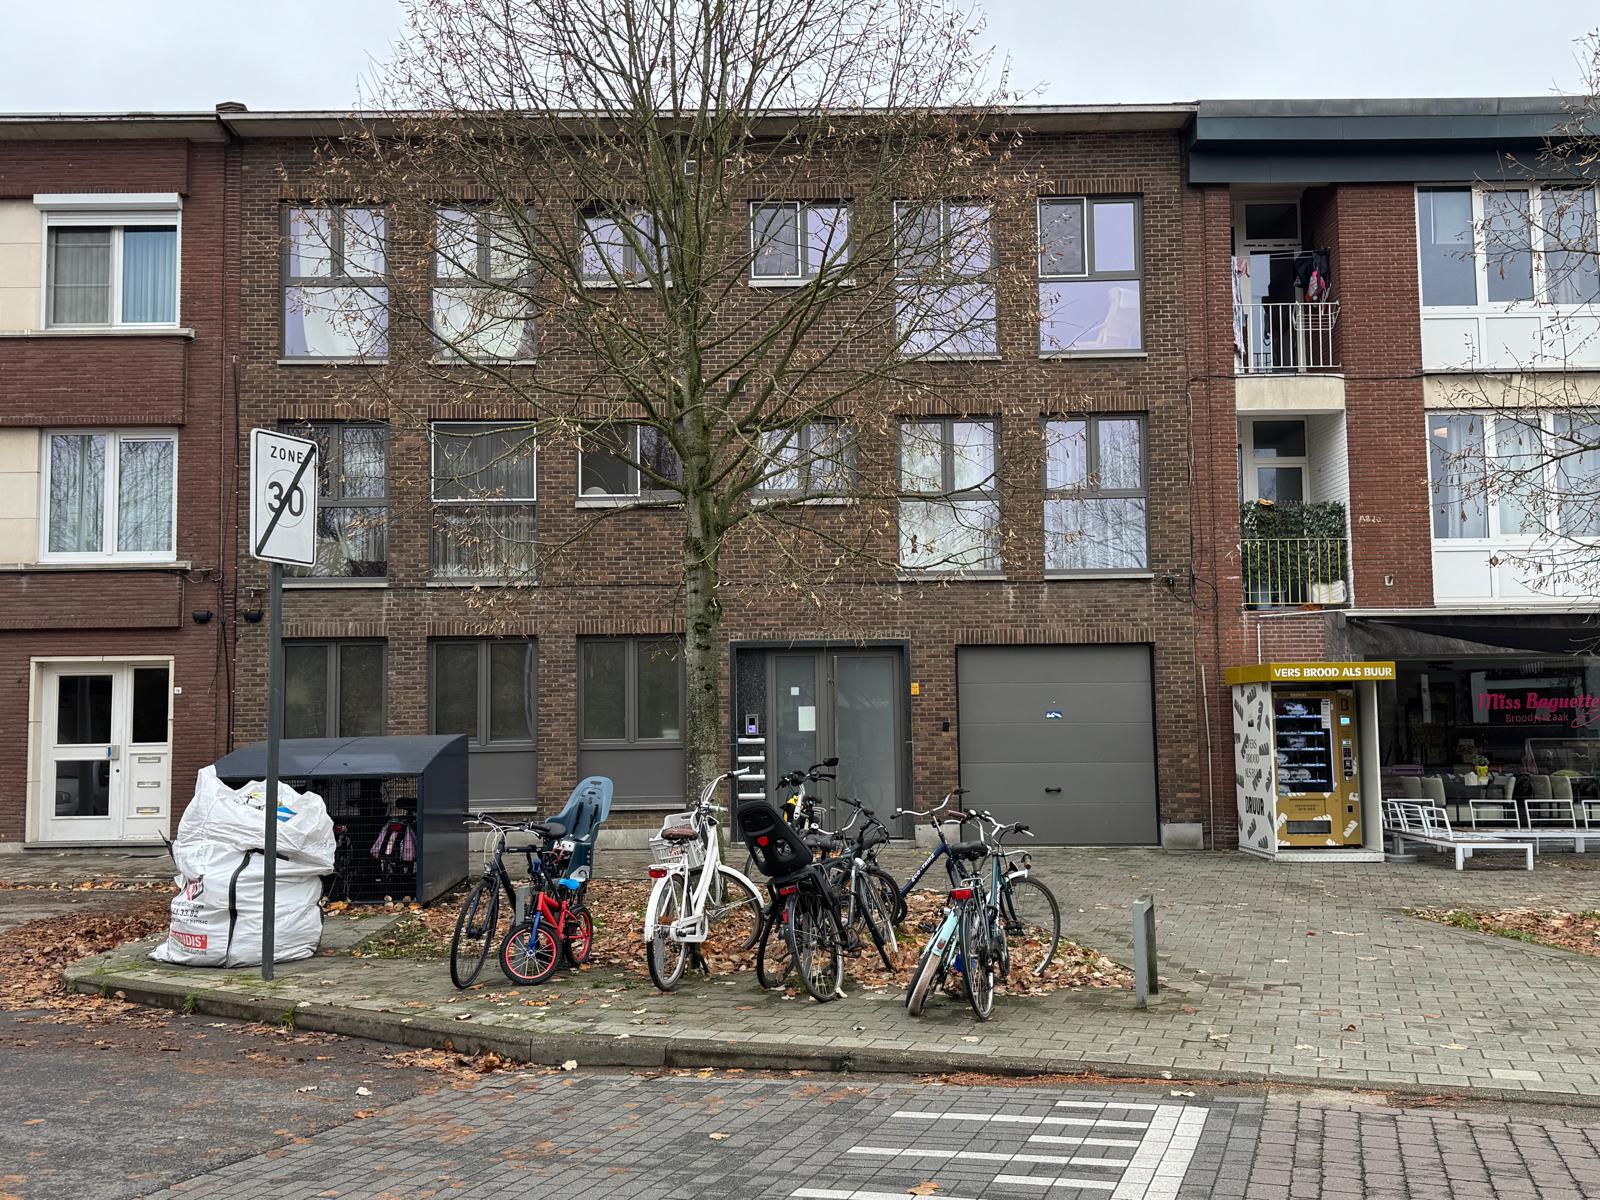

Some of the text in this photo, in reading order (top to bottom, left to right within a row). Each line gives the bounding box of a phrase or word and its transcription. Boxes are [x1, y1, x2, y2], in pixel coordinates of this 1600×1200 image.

[270, 445, 304, 464] ZONE
[267, 480, 304, 517] 30
[1274, 667, 1392, 677] VERS BROOD ALS BUUR
[1478, 692, 1600, 713] Miss Baguette
